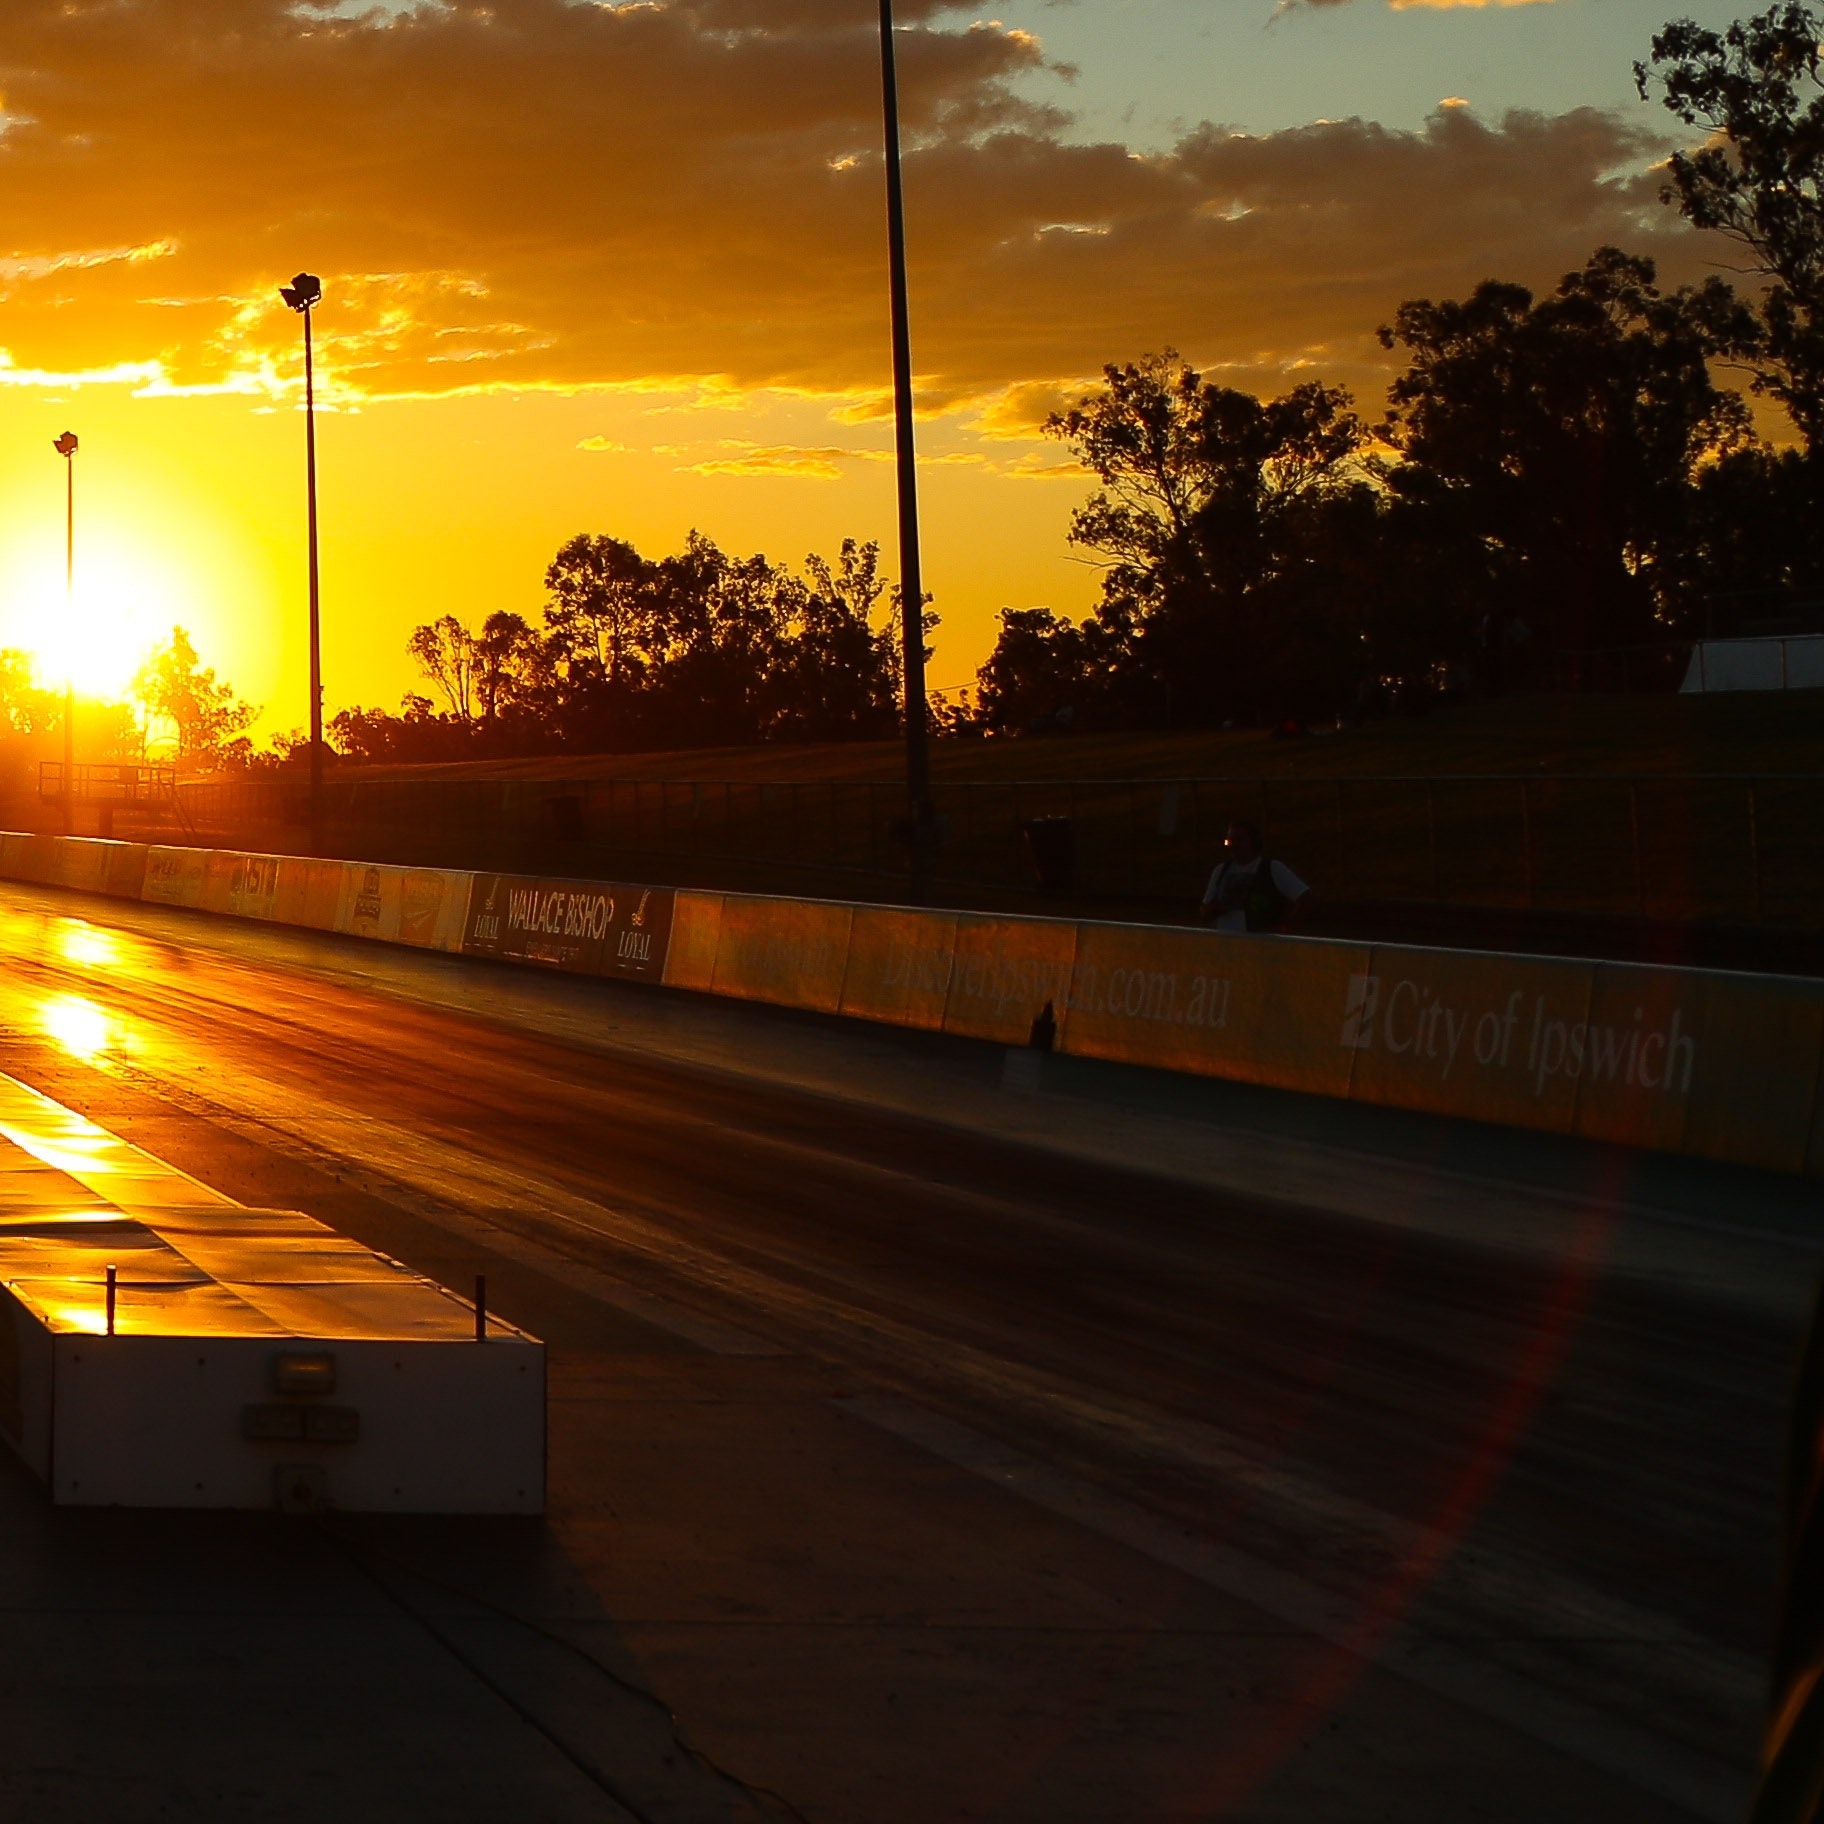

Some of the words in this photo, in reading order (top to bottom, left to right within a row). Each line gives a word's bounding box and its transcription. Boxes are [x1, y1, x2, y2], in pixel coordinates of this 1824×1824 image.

[508, 888, 566, 935] WALLACE
[616, 930, 651, 961] LOYAL
[1383, 979, 1470, 1081] City
[1473, 989, 1524, 1069] of
[1527, 992, 1695, 1099] Ipswich
